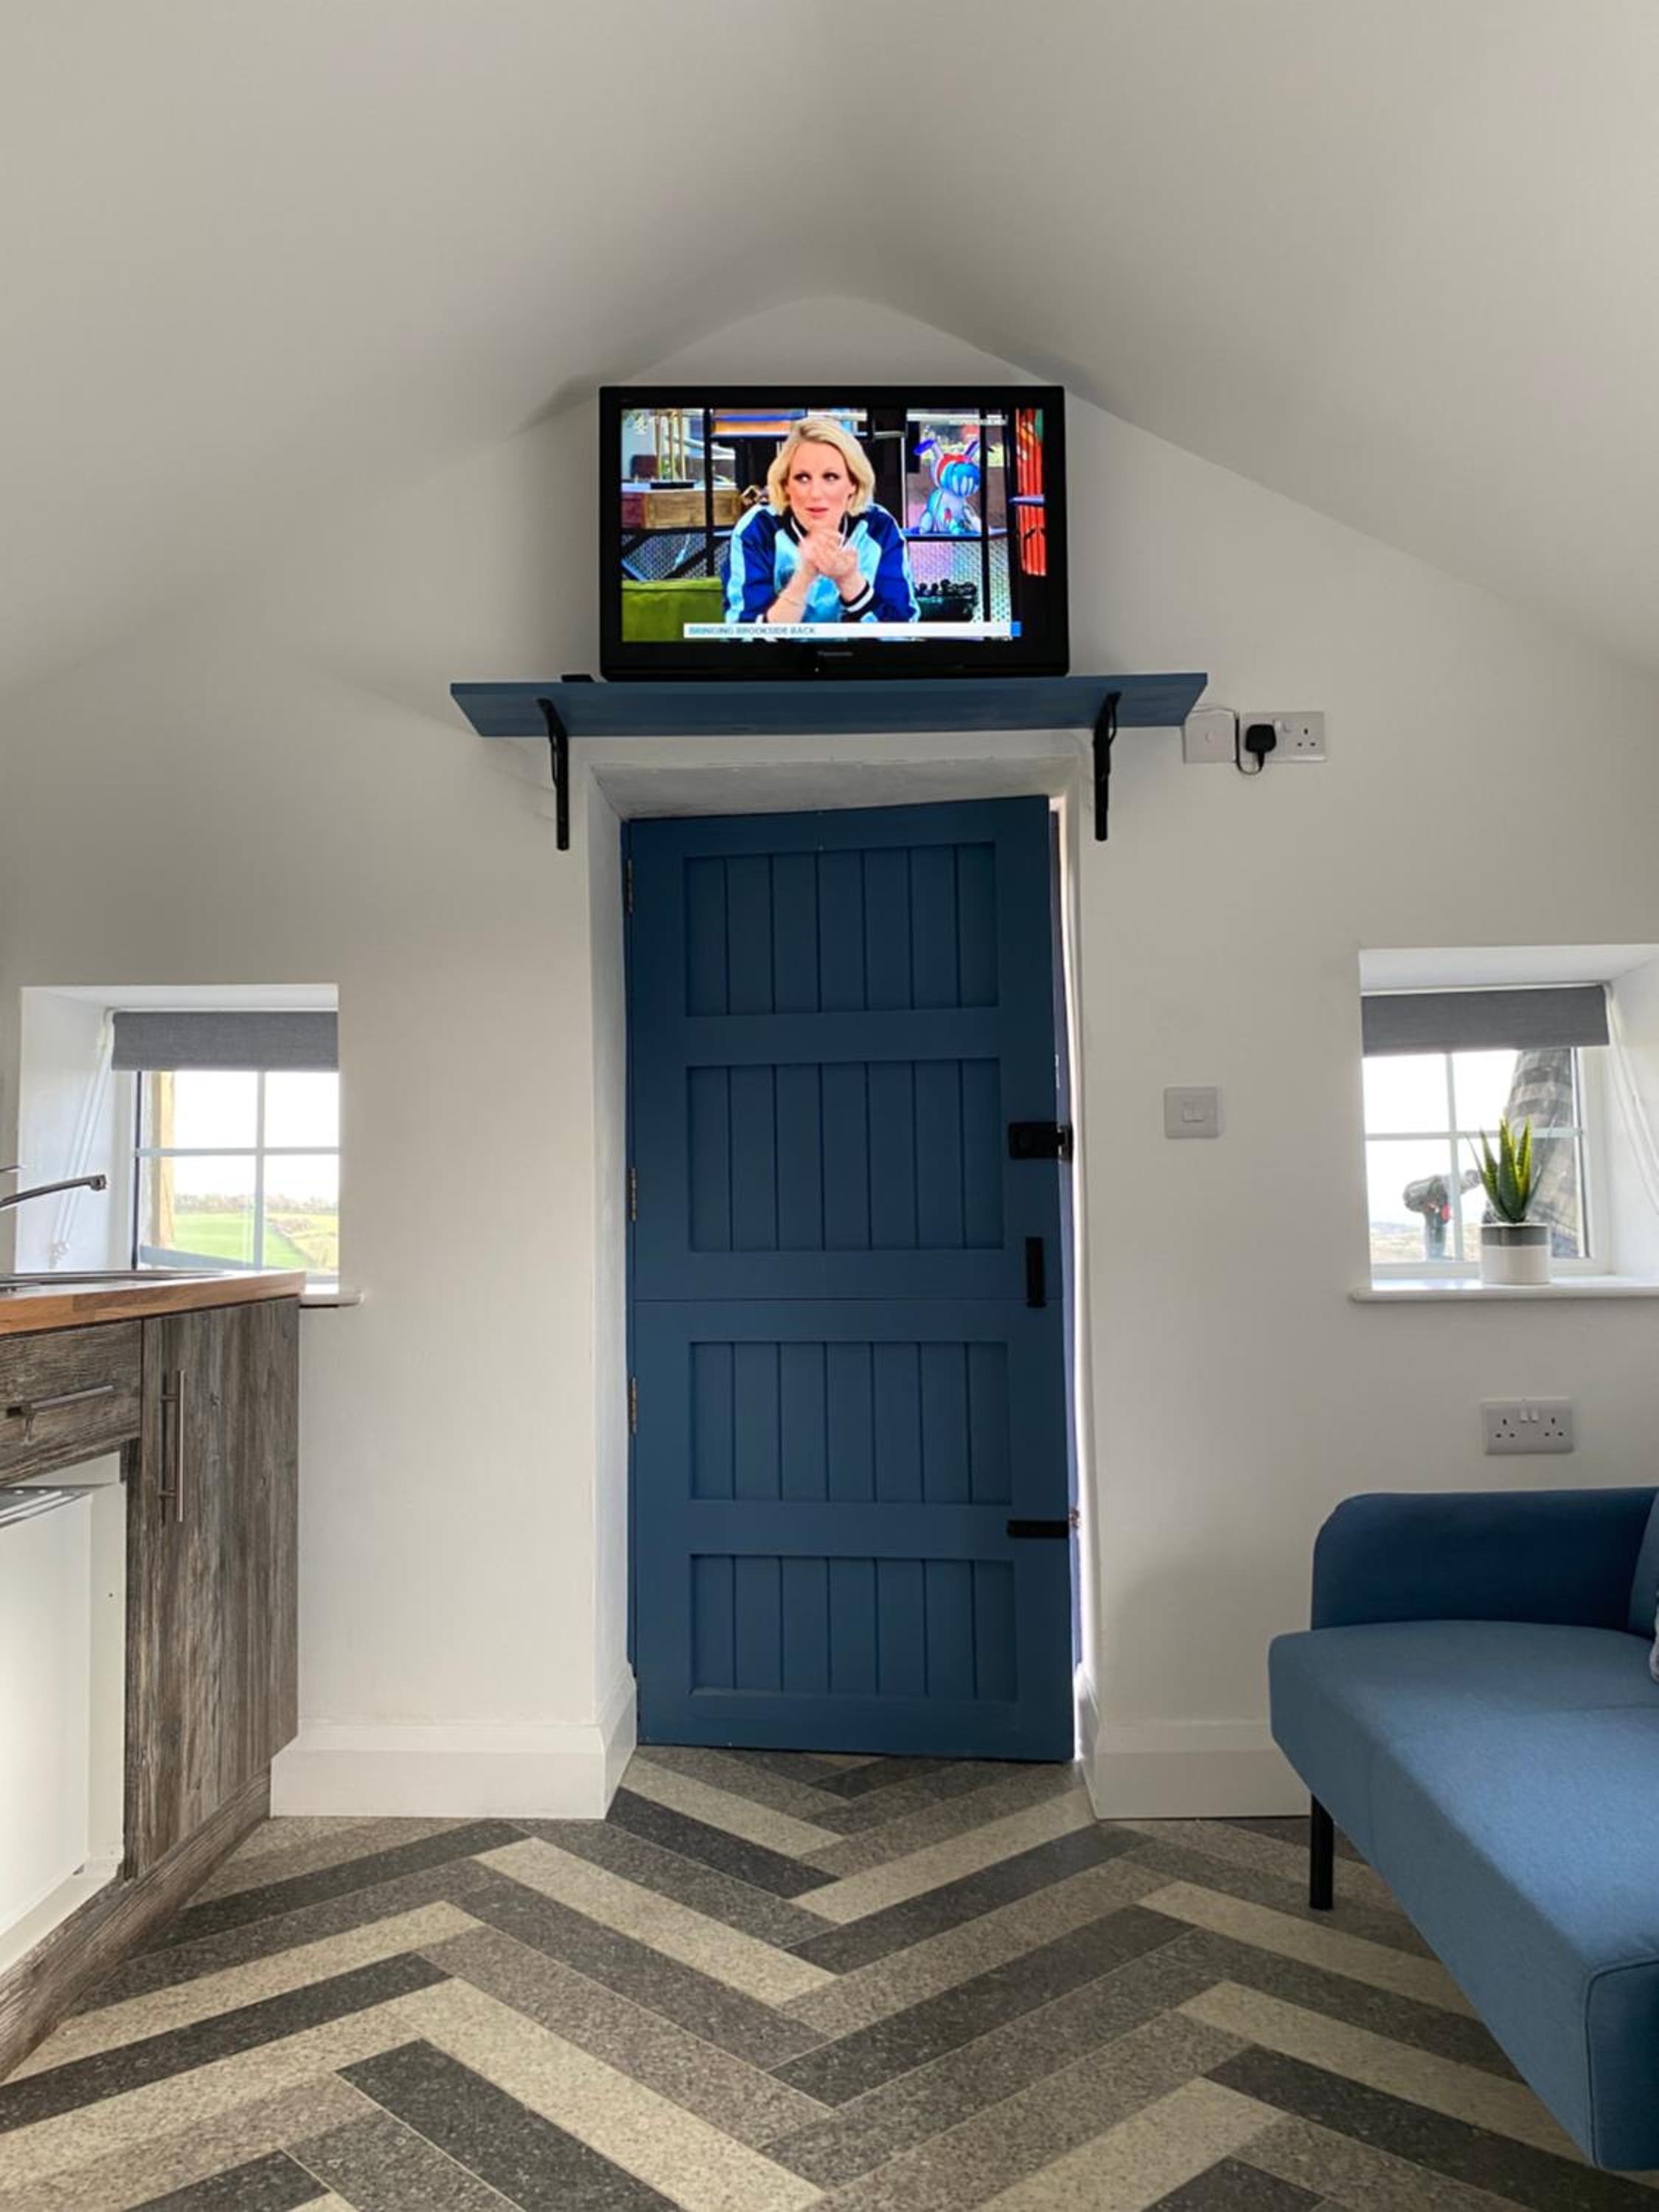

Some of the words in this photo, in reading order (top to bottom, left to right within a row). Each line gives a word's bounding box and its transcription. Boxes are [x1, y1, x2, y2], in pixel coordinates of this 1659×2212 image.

[688, 627, 733, 635] BRINGING
[735, 627, 787, 635] BROOKSIDE
[790, 627, 815, 635] BACK
